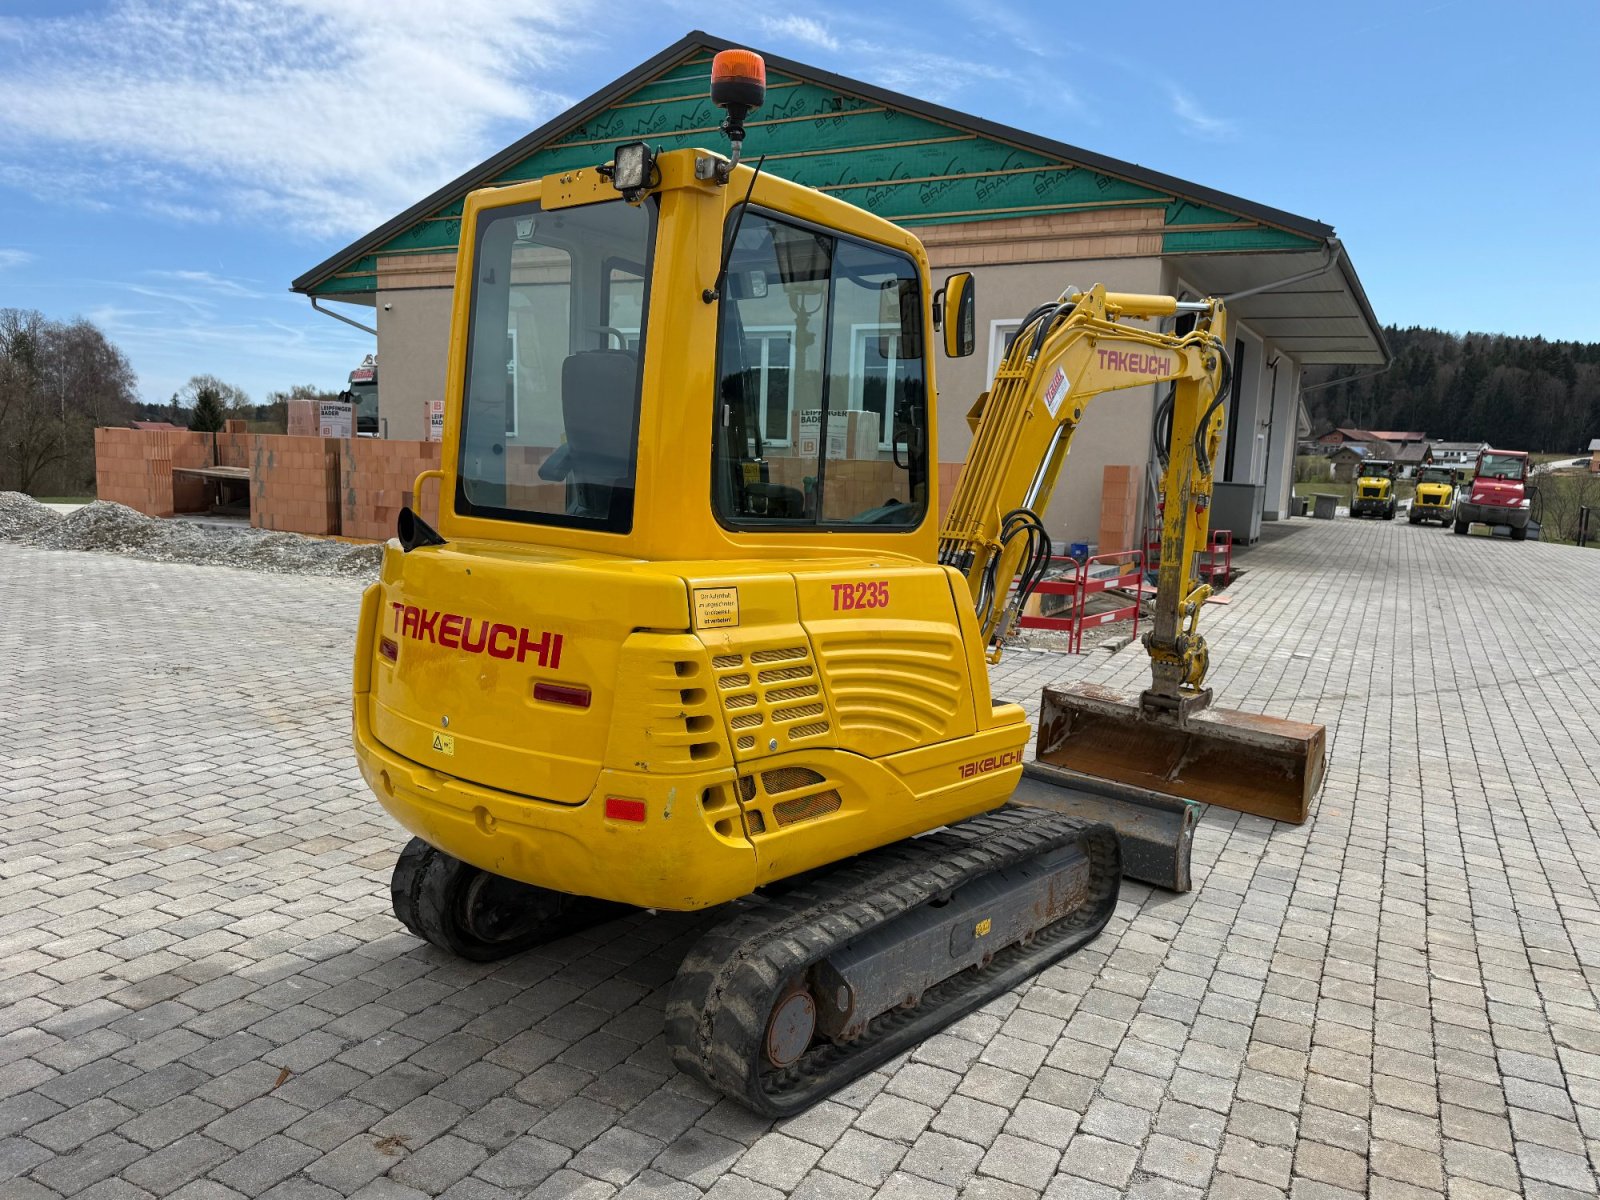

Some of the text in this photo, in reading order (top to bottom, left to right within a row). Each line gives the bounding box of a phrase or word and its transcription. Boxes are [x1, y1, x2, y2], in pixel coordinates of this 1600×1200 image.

[1035, 166, 1078, 196] BRAA
[1097, 349, 1171, 376] TAKEUCHI
[321, 405, 351, 413] LEIPFINGER
[801, 416, 822, 424] BADE
[831, 581, 889, 611] TB235
[392, 602, 564, 670] TAKEUCHI
